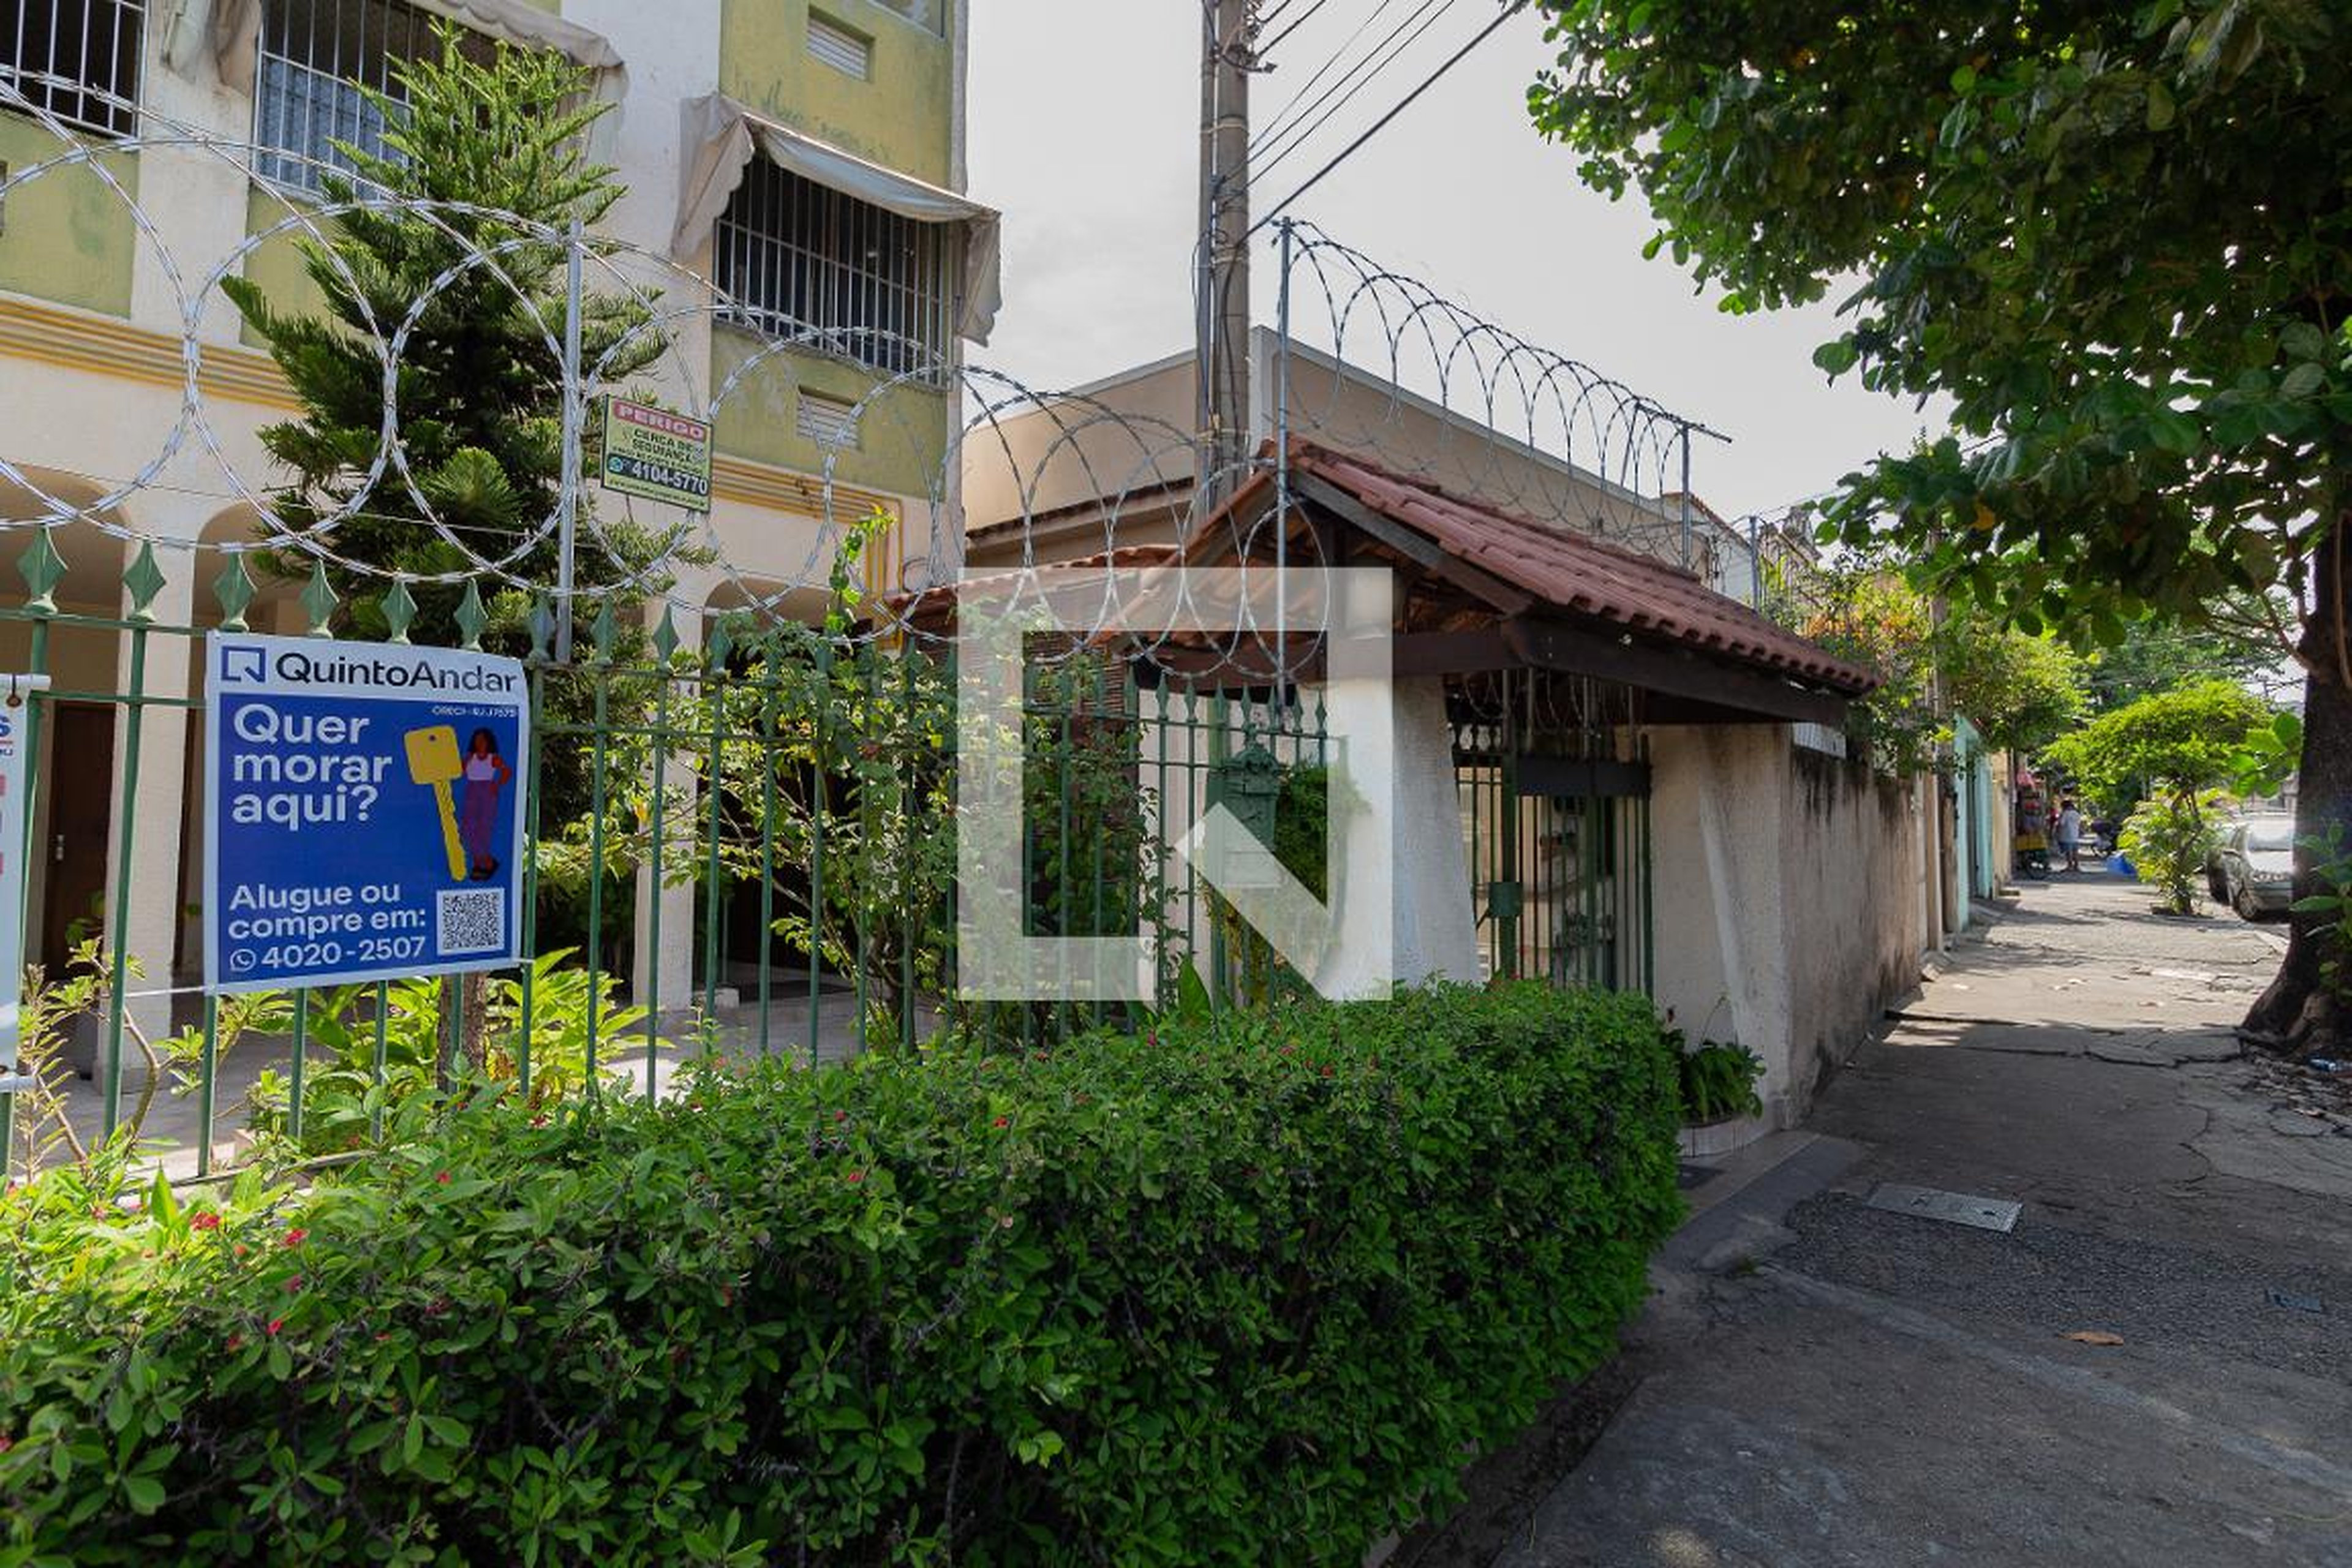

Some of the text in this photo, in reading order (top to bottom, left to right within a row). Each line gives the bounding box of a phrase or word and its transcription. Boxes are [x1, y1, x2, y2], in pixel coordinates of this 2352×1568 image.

[619, 404, 704, 439] PERIGO
[633, 428, 675, 449] CERCA
[631, 461, 708, 495] 4104-5770
[276, 652, 518, 692] QuintoAndar
[233, 703, 370, 745] Quer
[233, 754, 392, 783] morar
[232, 784, 379, 831] aqui?
[229, 884, 400, 913] Alugue ou
[228, 908, 426, 940] compre em:
